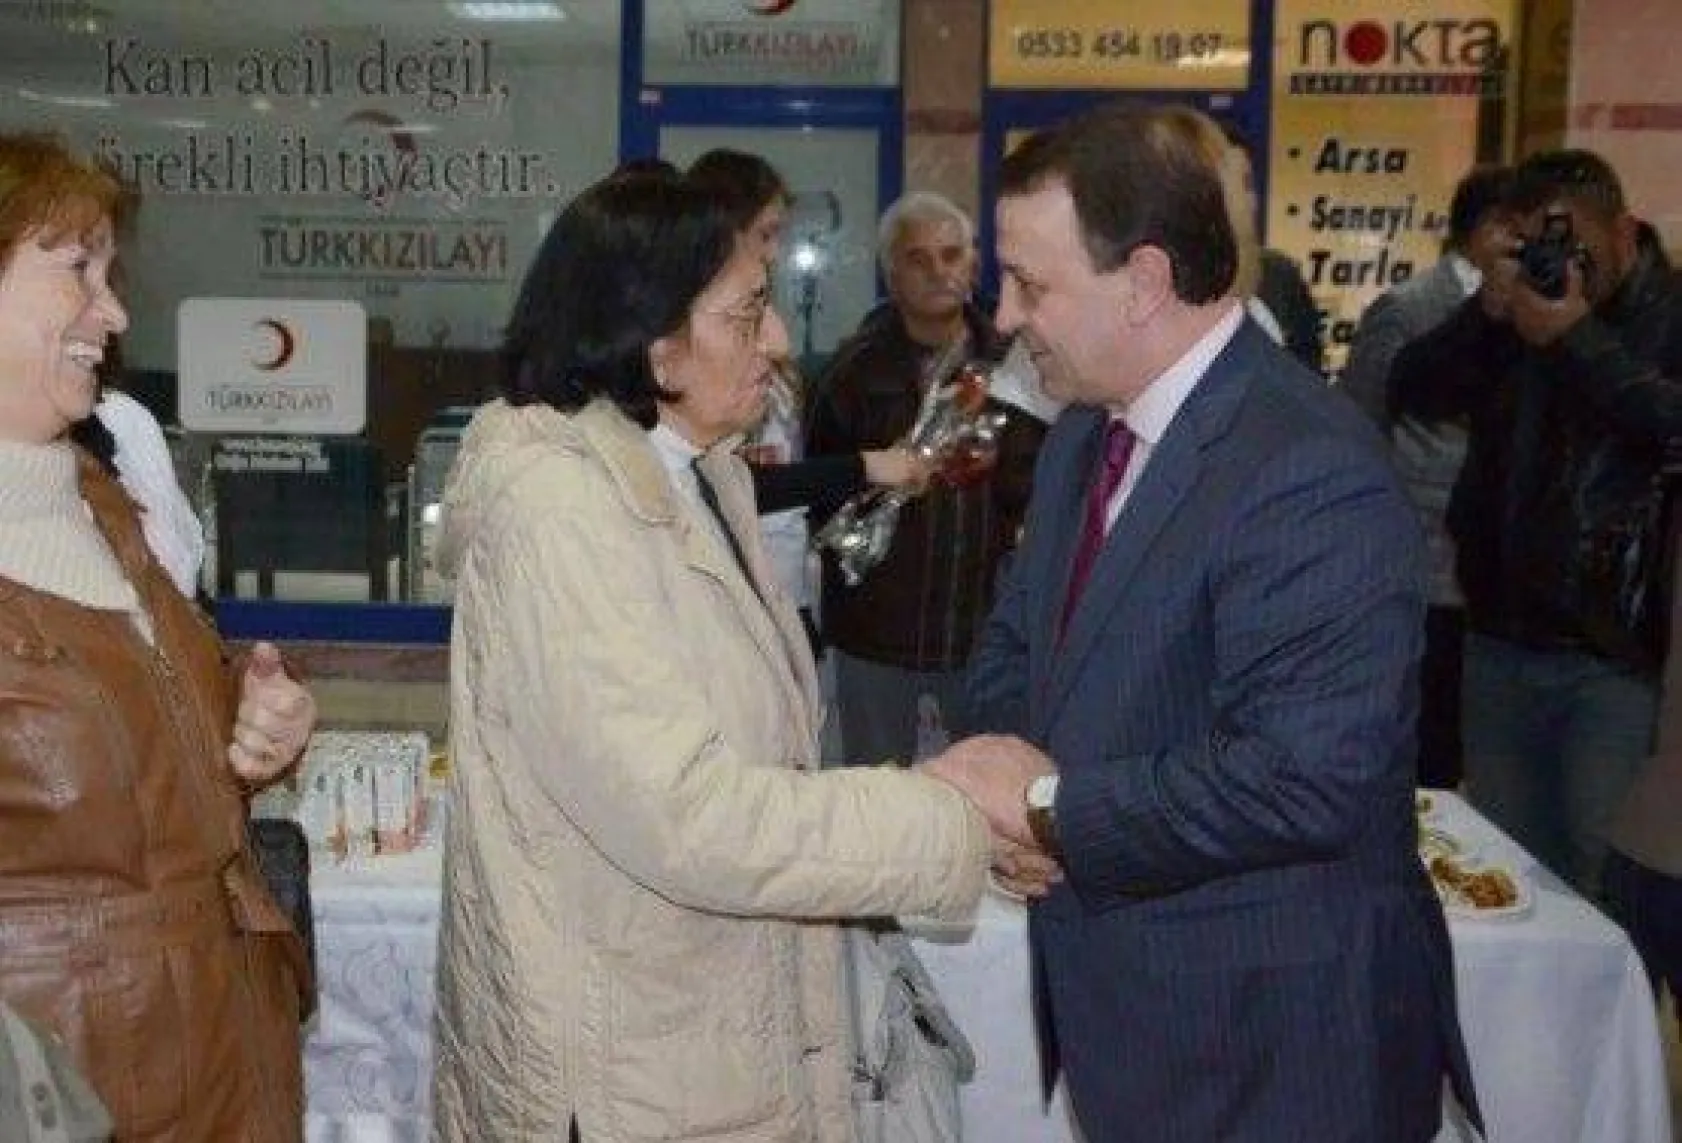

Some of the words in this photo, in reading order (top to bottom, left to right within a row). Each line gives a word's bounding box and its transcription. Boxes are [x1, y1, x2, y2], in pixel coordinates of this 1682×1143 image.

[1091, 30, 1142, 57] 454
[104, 40, 213, 96] Kan
[236, 40, 333, 96] acil
[357, 40, 511, 108] değil,
[95, 135, 256, 193] ürekli
[280, 135, 558, 204] ihtiyaçtır.
[1312, 138, 1409, 174] Arsa
[1309, 194, 1416, 242] Sanayi
[1308, 249, 1414, 286] Tarla
